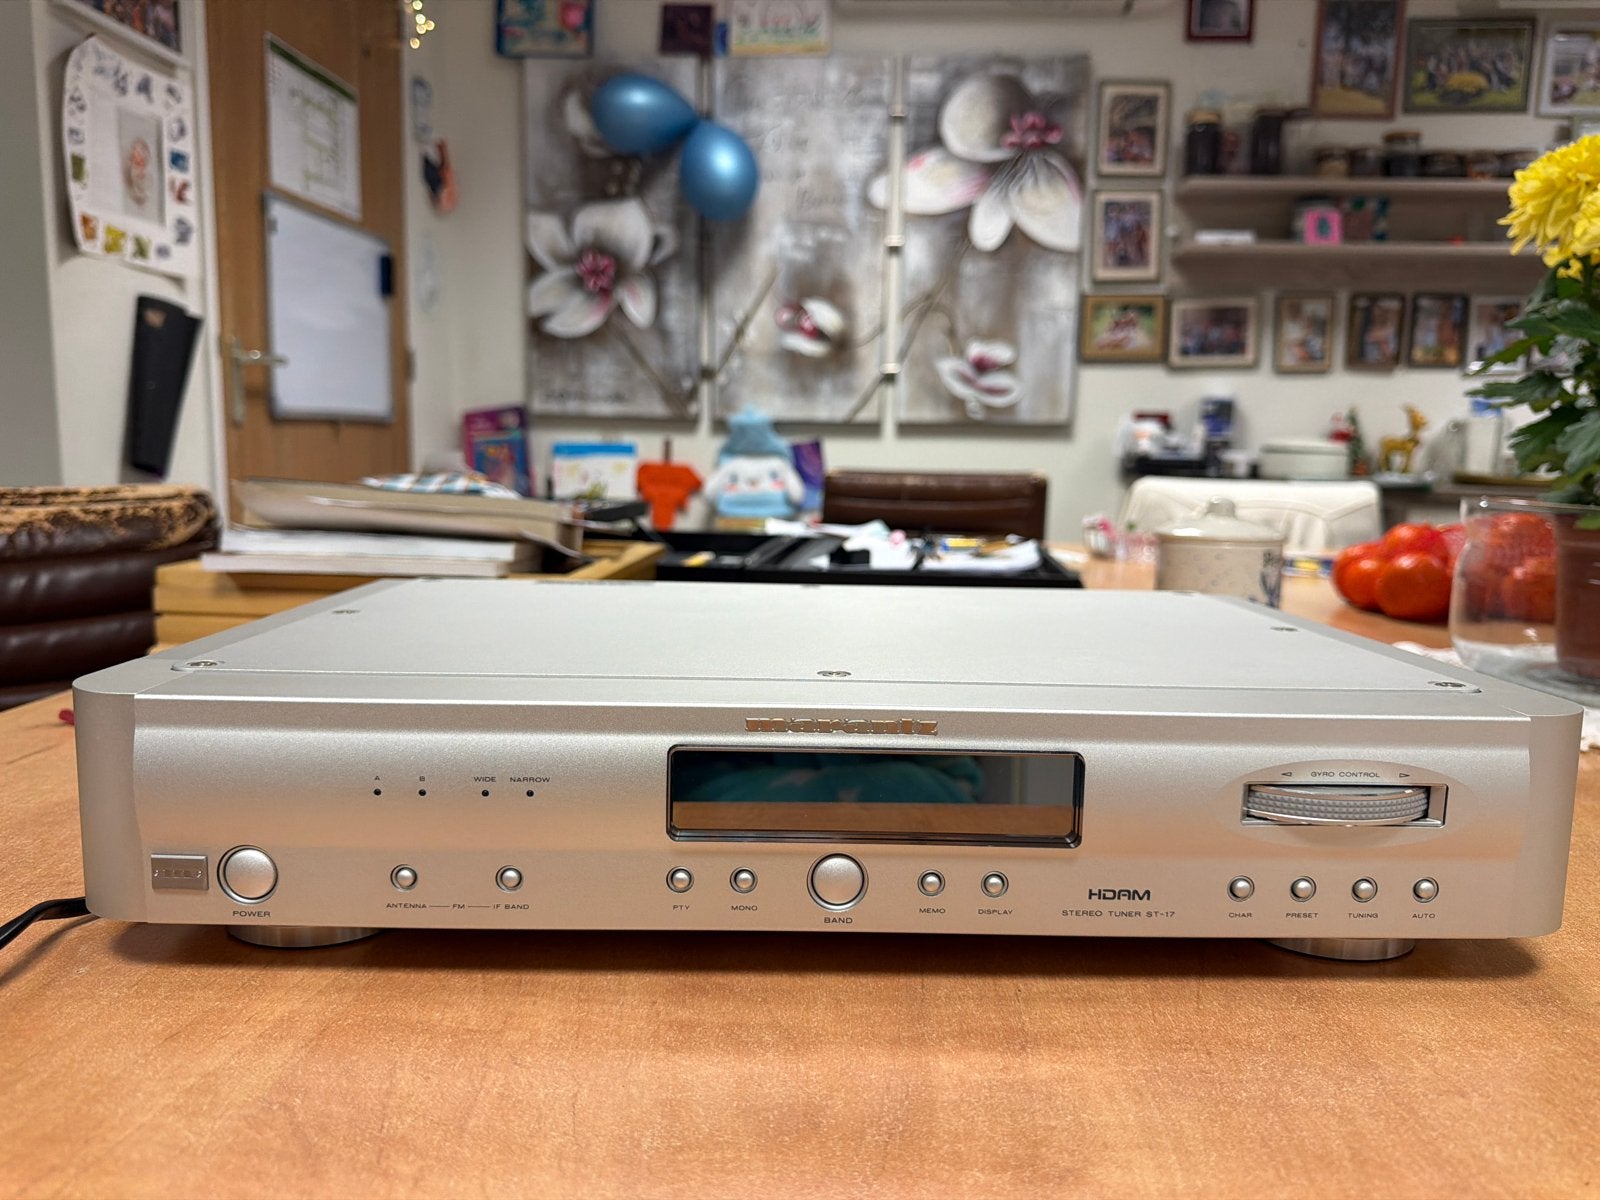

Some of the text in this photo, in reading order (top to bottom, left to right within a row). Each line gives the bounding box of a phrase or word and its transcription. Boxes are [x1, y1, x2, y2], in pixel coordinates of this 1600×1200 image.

[745, 717, 938, 736] marantz
[1088, 888, 1152, 901] HDAM
[232, 910, 271, 918] POWER
[1061, 909, 1103, 917] STEREO
[1107, 910, 1142, 918] TUNER
[823, 916, 854, 924] BAND
